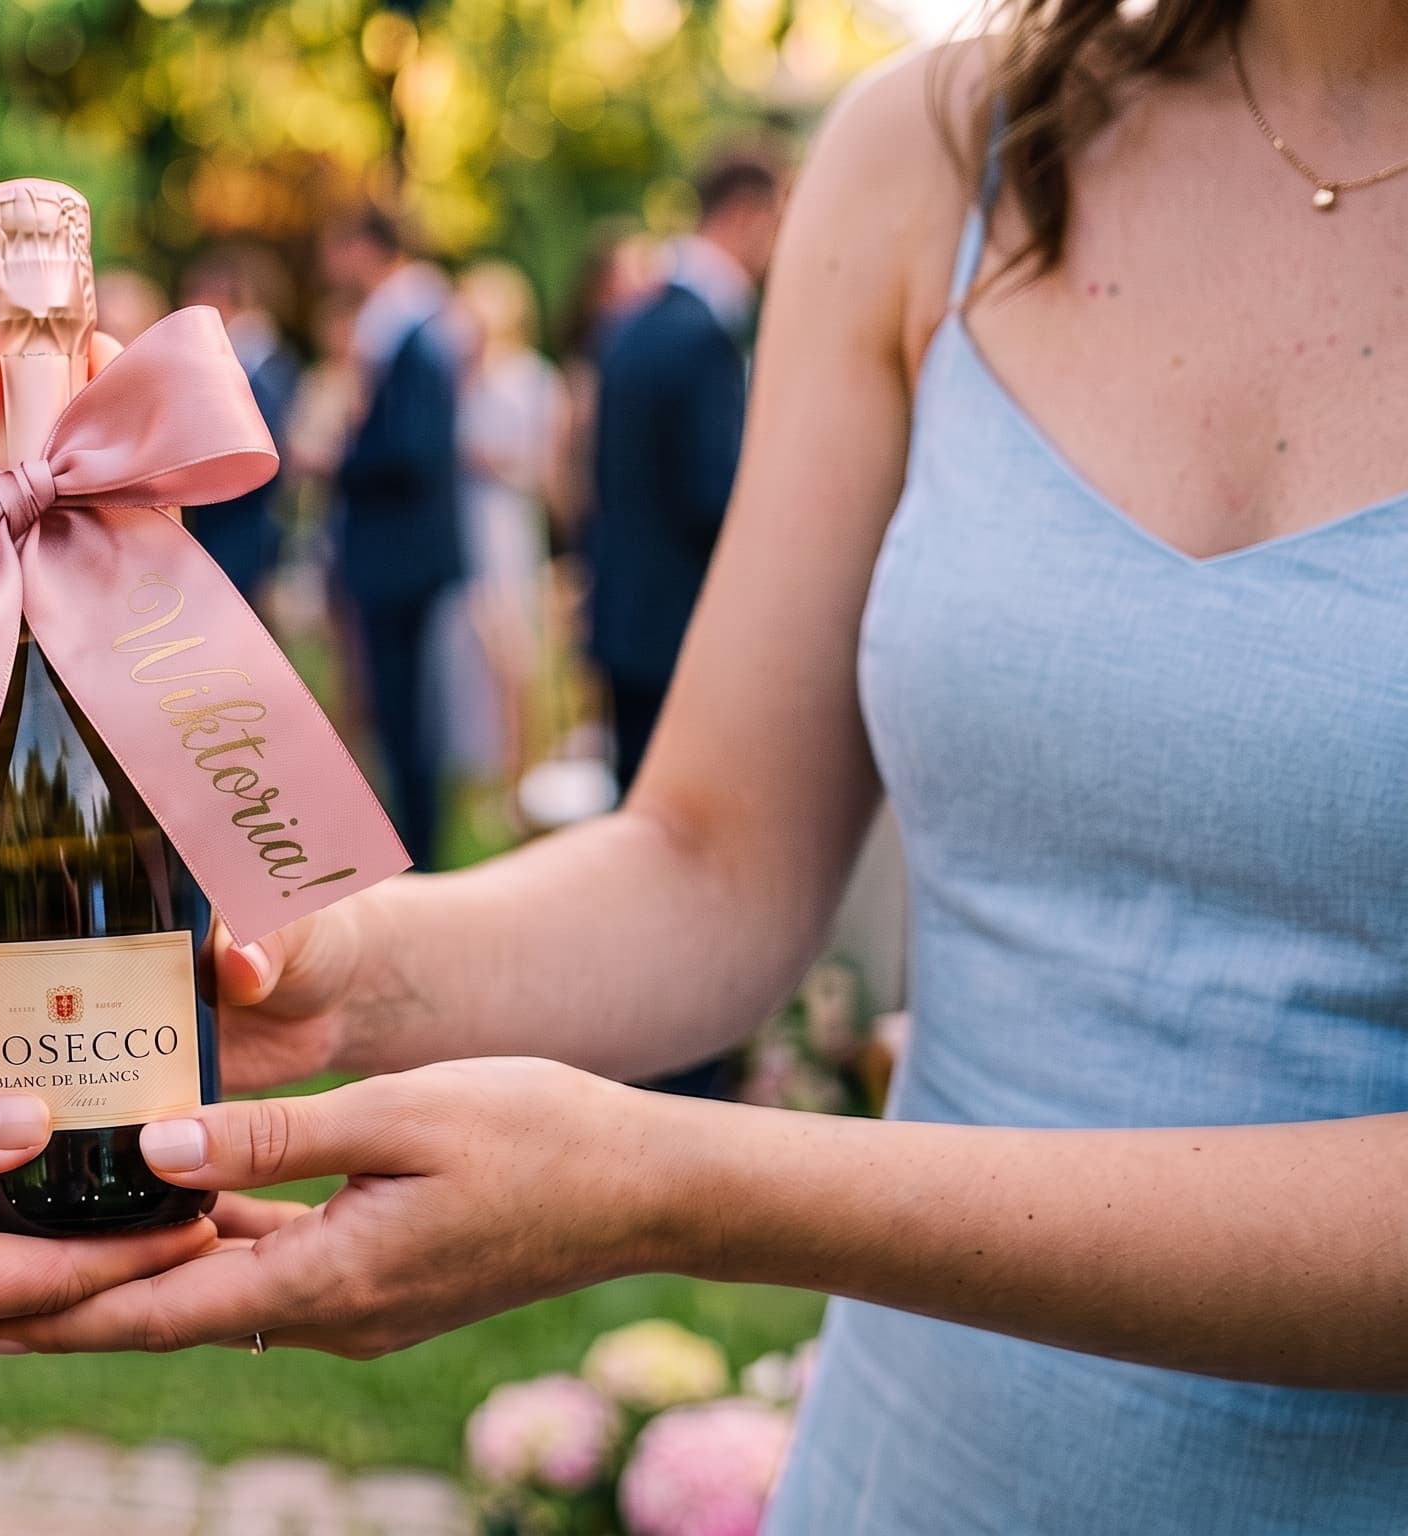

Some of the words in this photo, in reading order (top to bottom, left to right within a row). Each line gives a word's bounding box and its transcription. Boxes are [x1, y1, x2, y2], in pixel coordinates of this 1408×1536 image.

[111, 571, 358, 898] Wiktoria!
[52, 1075, 73, 1087] DE
[79, 1069, 140, 1086] BLANCS
